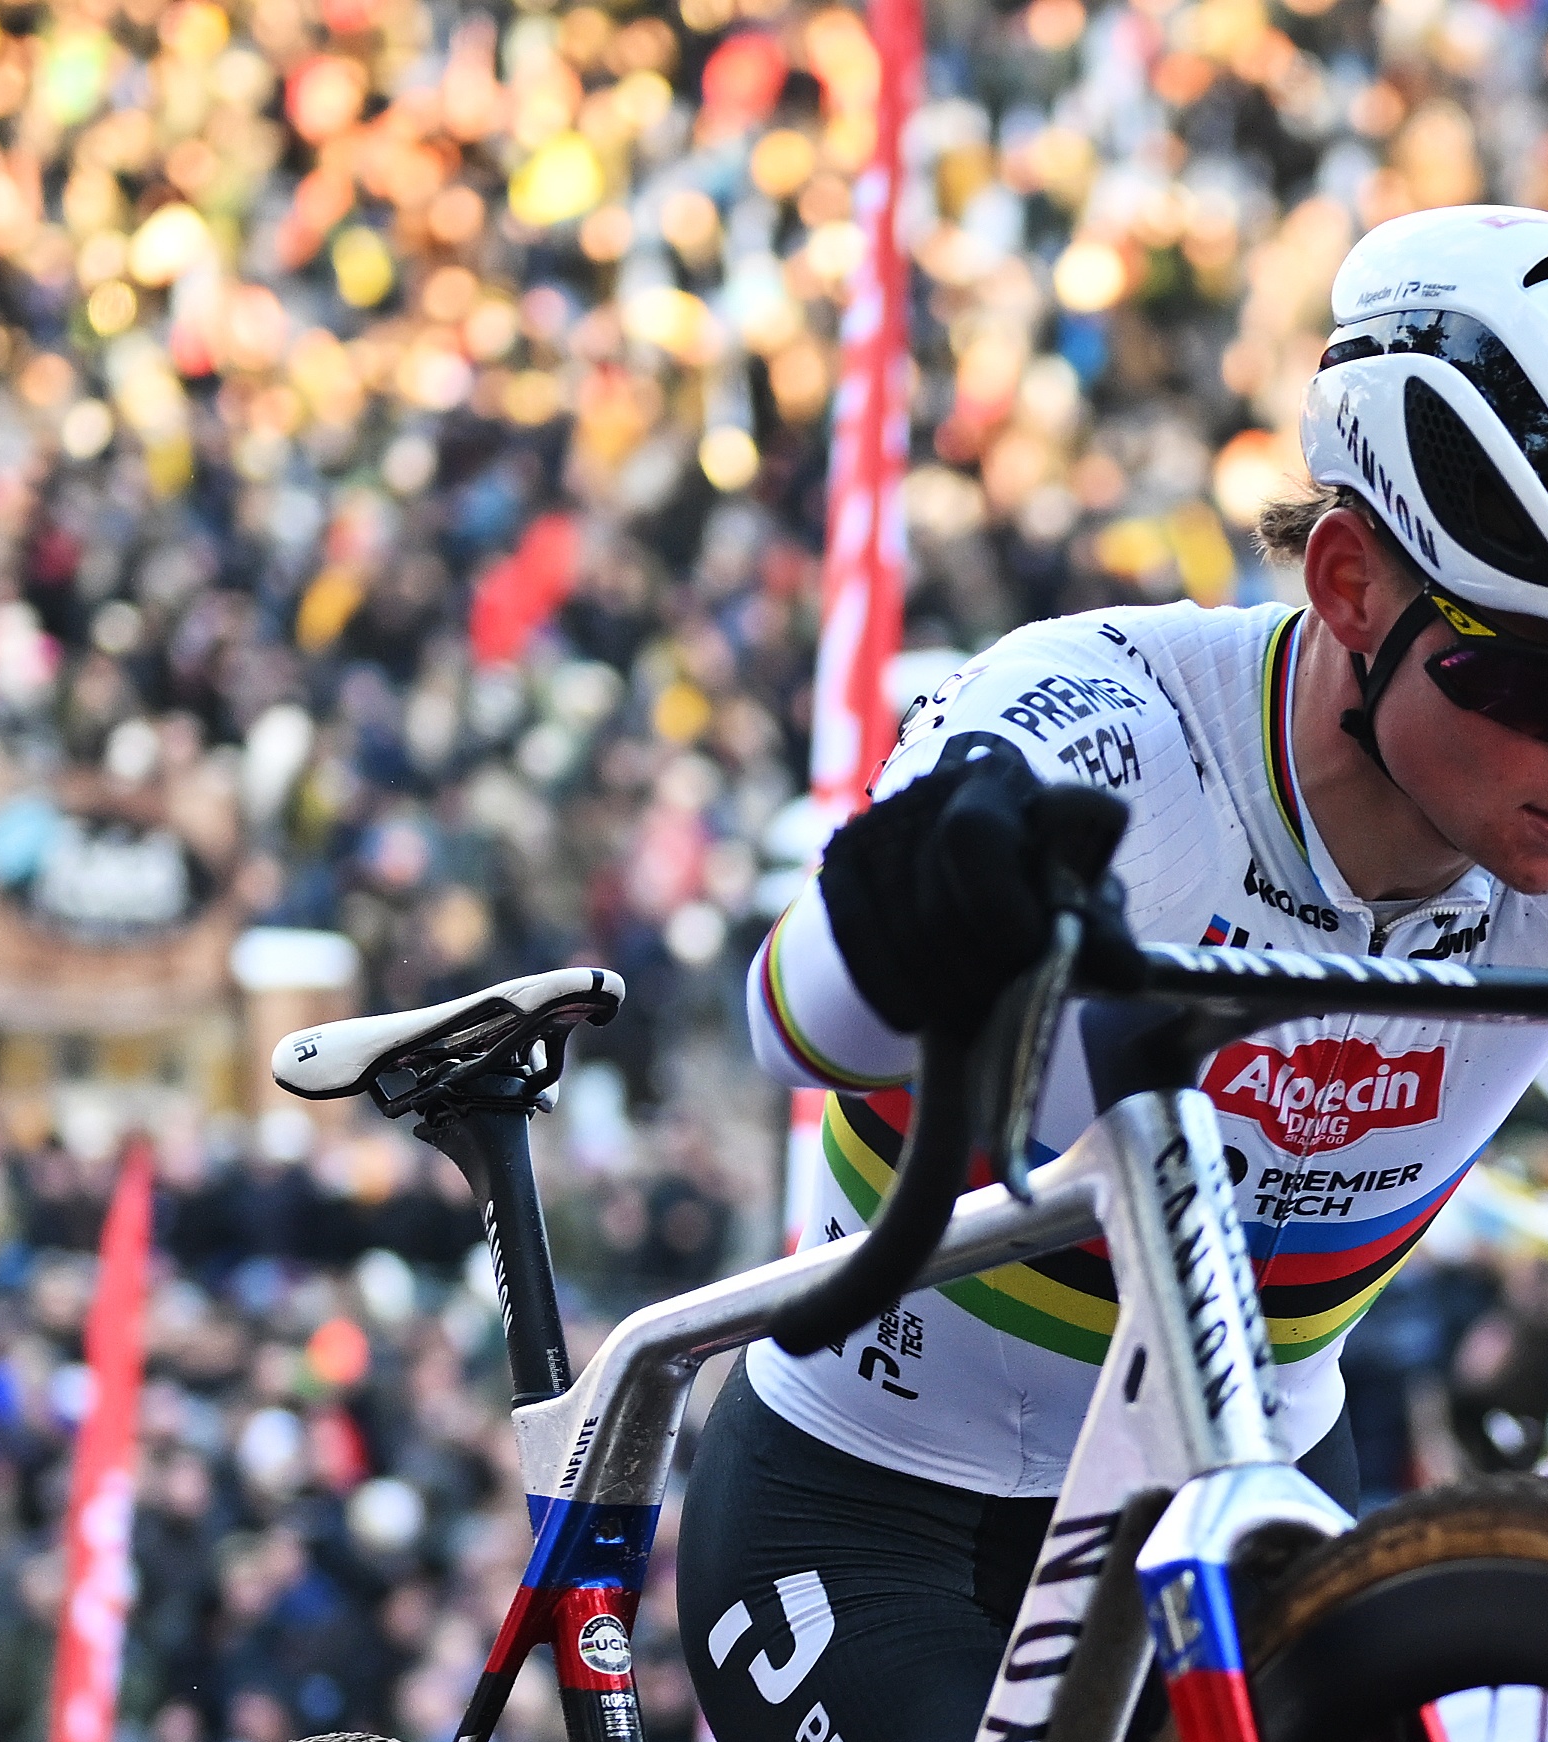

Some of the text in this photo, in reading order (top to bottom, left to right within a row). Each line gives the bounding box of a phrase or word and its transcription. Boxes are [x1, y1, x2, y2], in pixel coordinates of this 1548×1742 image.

[1338, 390, 1440, 570] CANYON
[1057, 722, 1141, 790] TECH
[1222, 1055, 1420, 1124] Alpecin
[1287, 1112, 1350, 1138] DMG
[1254, 1194, 1354, 1221] TECH
[1257, 1163, 1423, 1194] PREMIER
[485, 1200, 513, 1340] CANYON
[1154, 1133, 1240, 1420] CANYON
[900, 1310, 923, 1359] TECH
[559, 1415, 600, 1490] INFLITE
[595, 1638, 624, 1651] UCI
